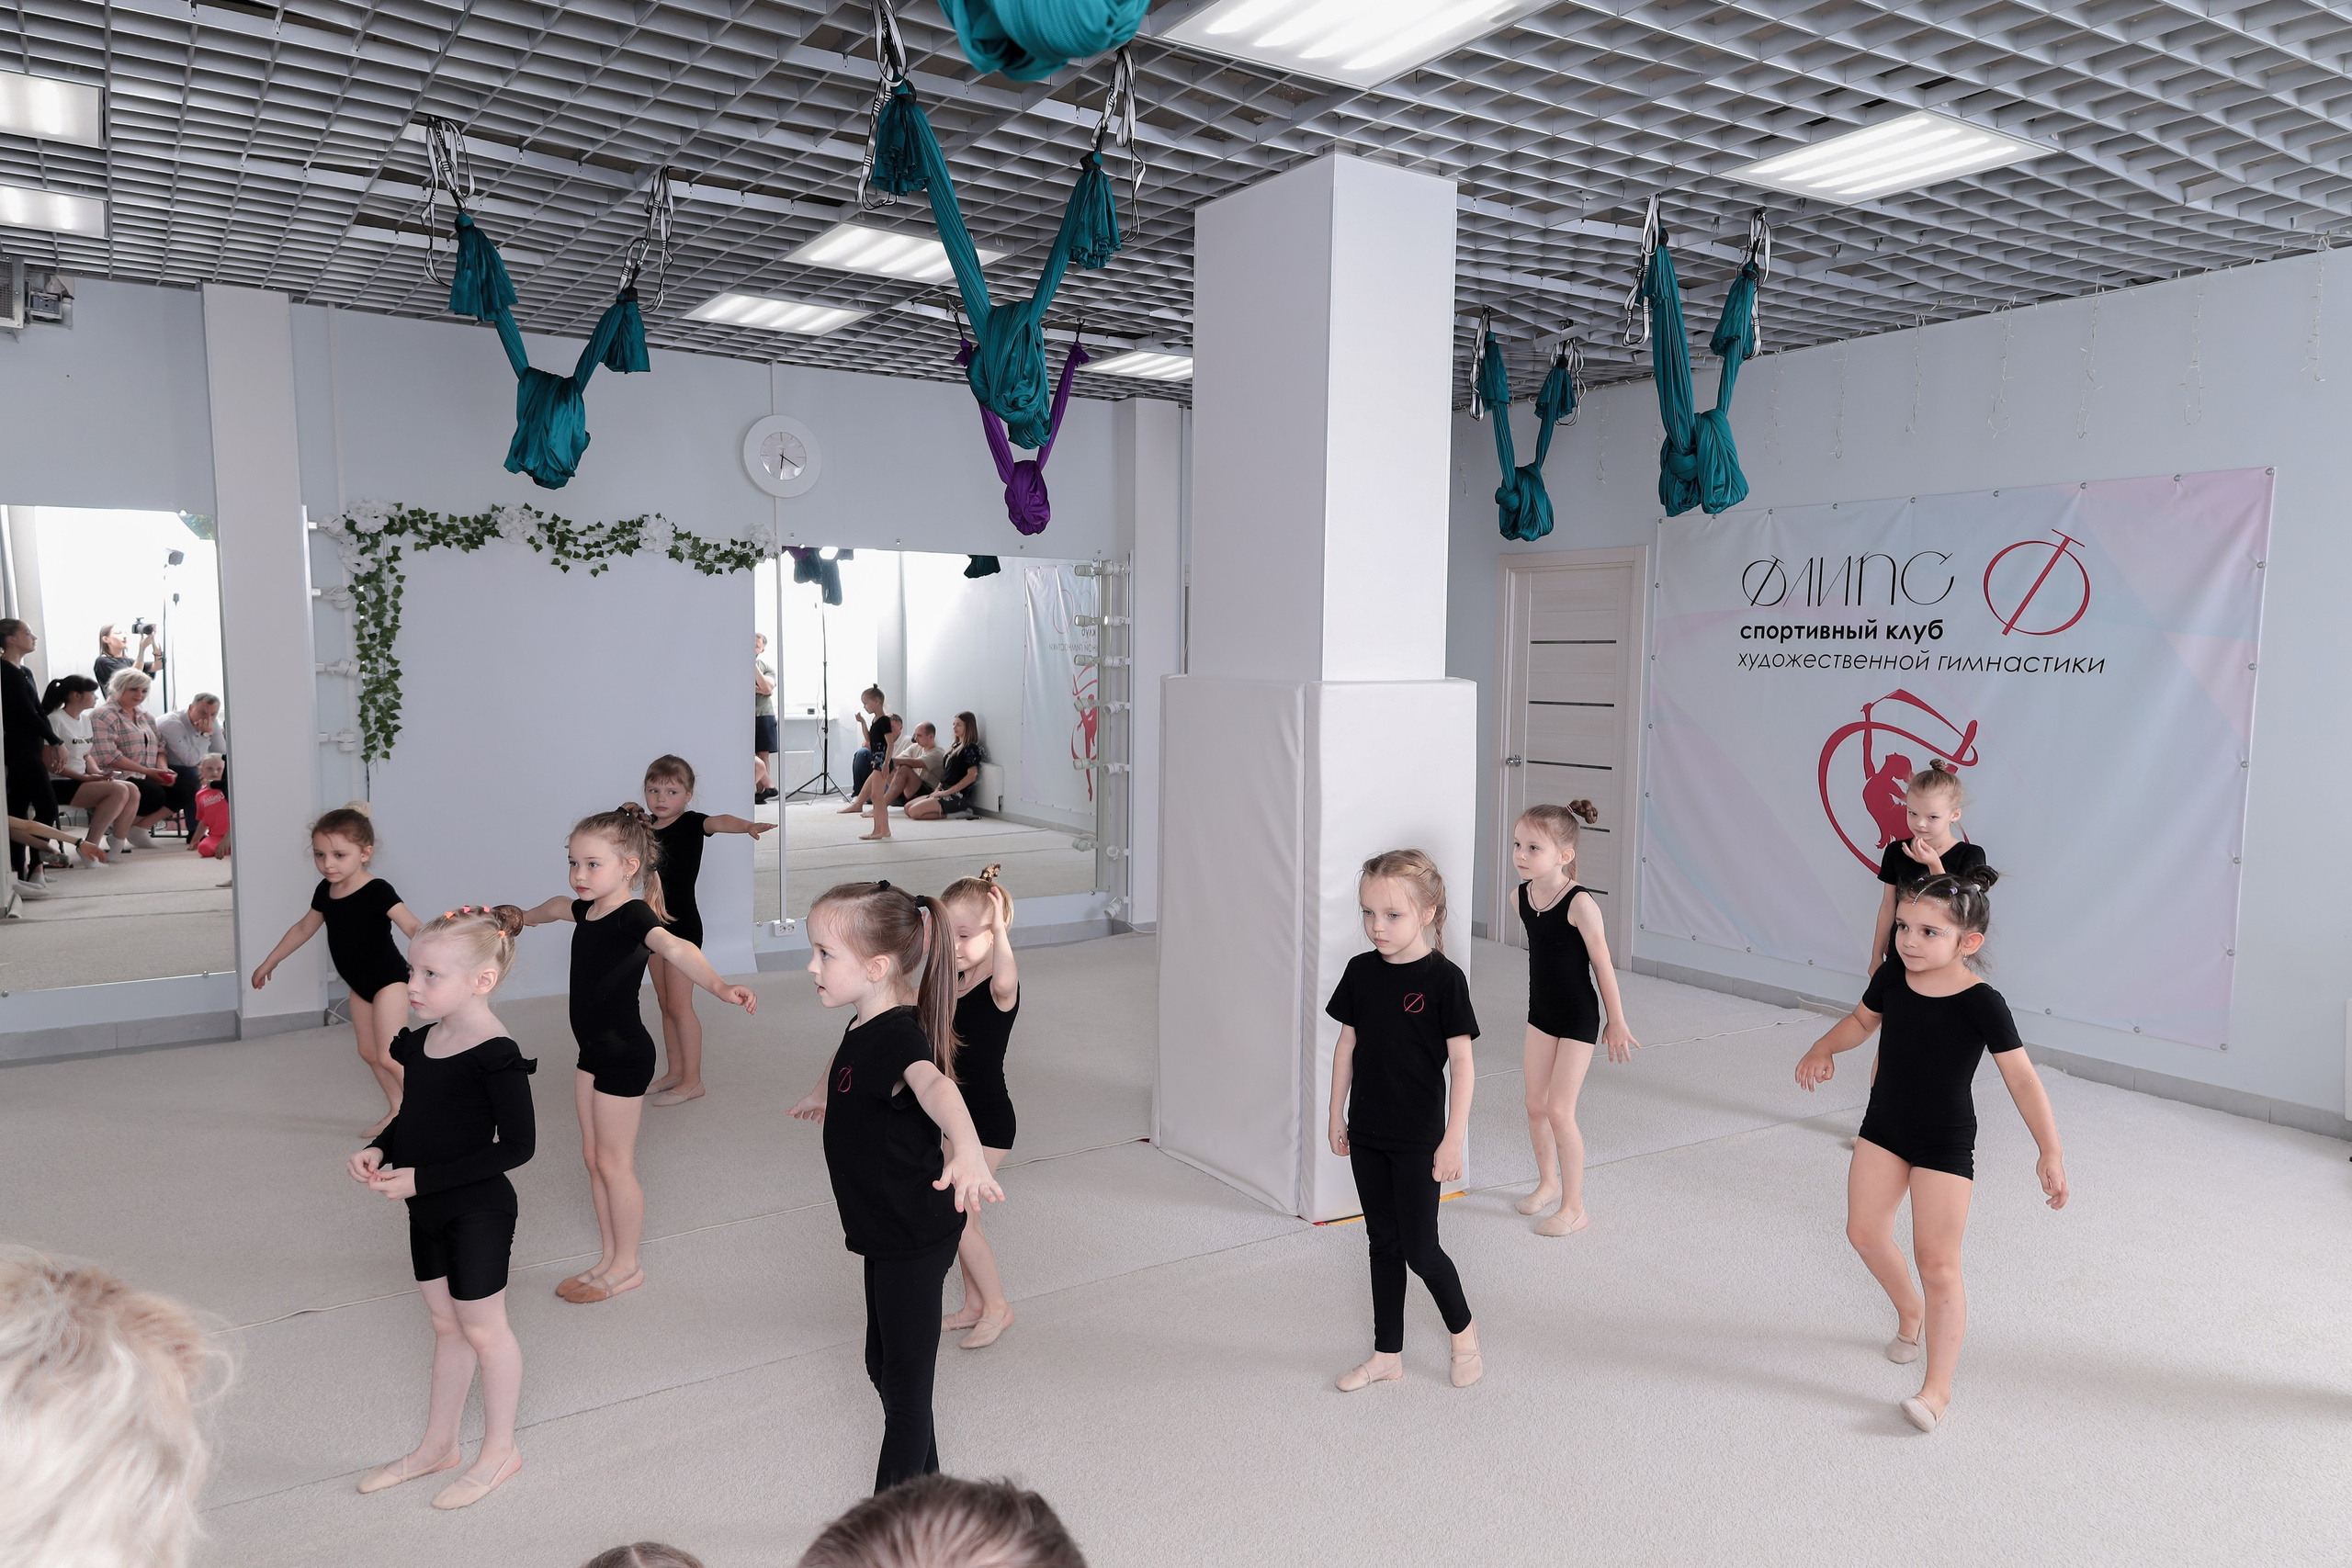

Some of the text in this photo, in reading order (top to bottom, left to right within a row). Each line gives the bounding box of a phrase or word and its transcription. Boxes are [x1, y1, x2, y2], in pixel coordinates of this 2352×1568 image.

[1740, 619, 1944, 644] спортивный клуб
[1737, 649, 2106, 674] художественной гимнастики
